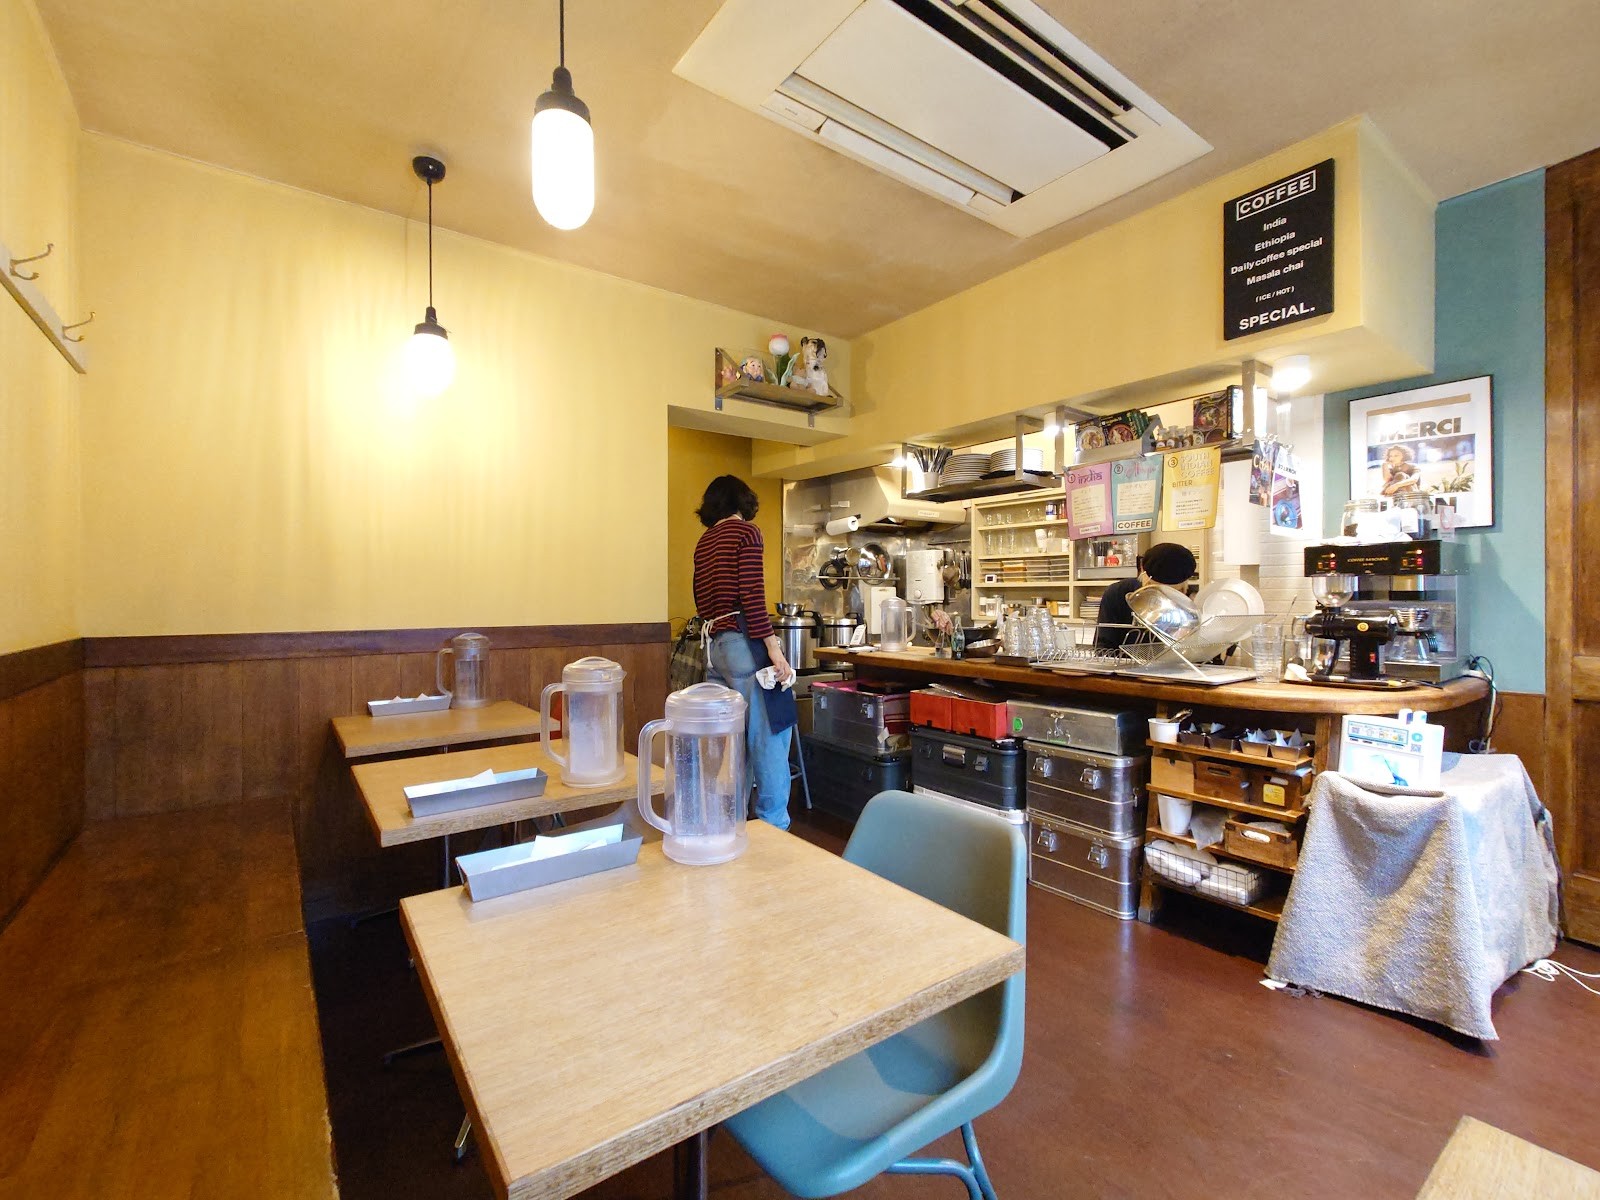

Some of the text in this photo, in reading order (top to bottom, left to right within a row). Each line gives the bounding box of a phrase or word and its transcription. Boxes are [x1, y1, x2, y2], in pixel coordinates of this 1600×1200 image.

[1239, 176, 1311, 215] COFFEE
[1263, 216, 1287, 232] India
[1254, 230, 1296, 252] Ethiopia
[1286, 237, 1323, 260] special
[1246, 260, 1304, 286] Masala chai
[1239, 302, 1316, 330] SPECIAL.
[1172, 480, 1193, 488] BITTER
[1117, 519, 1152, 529] COFFEE
